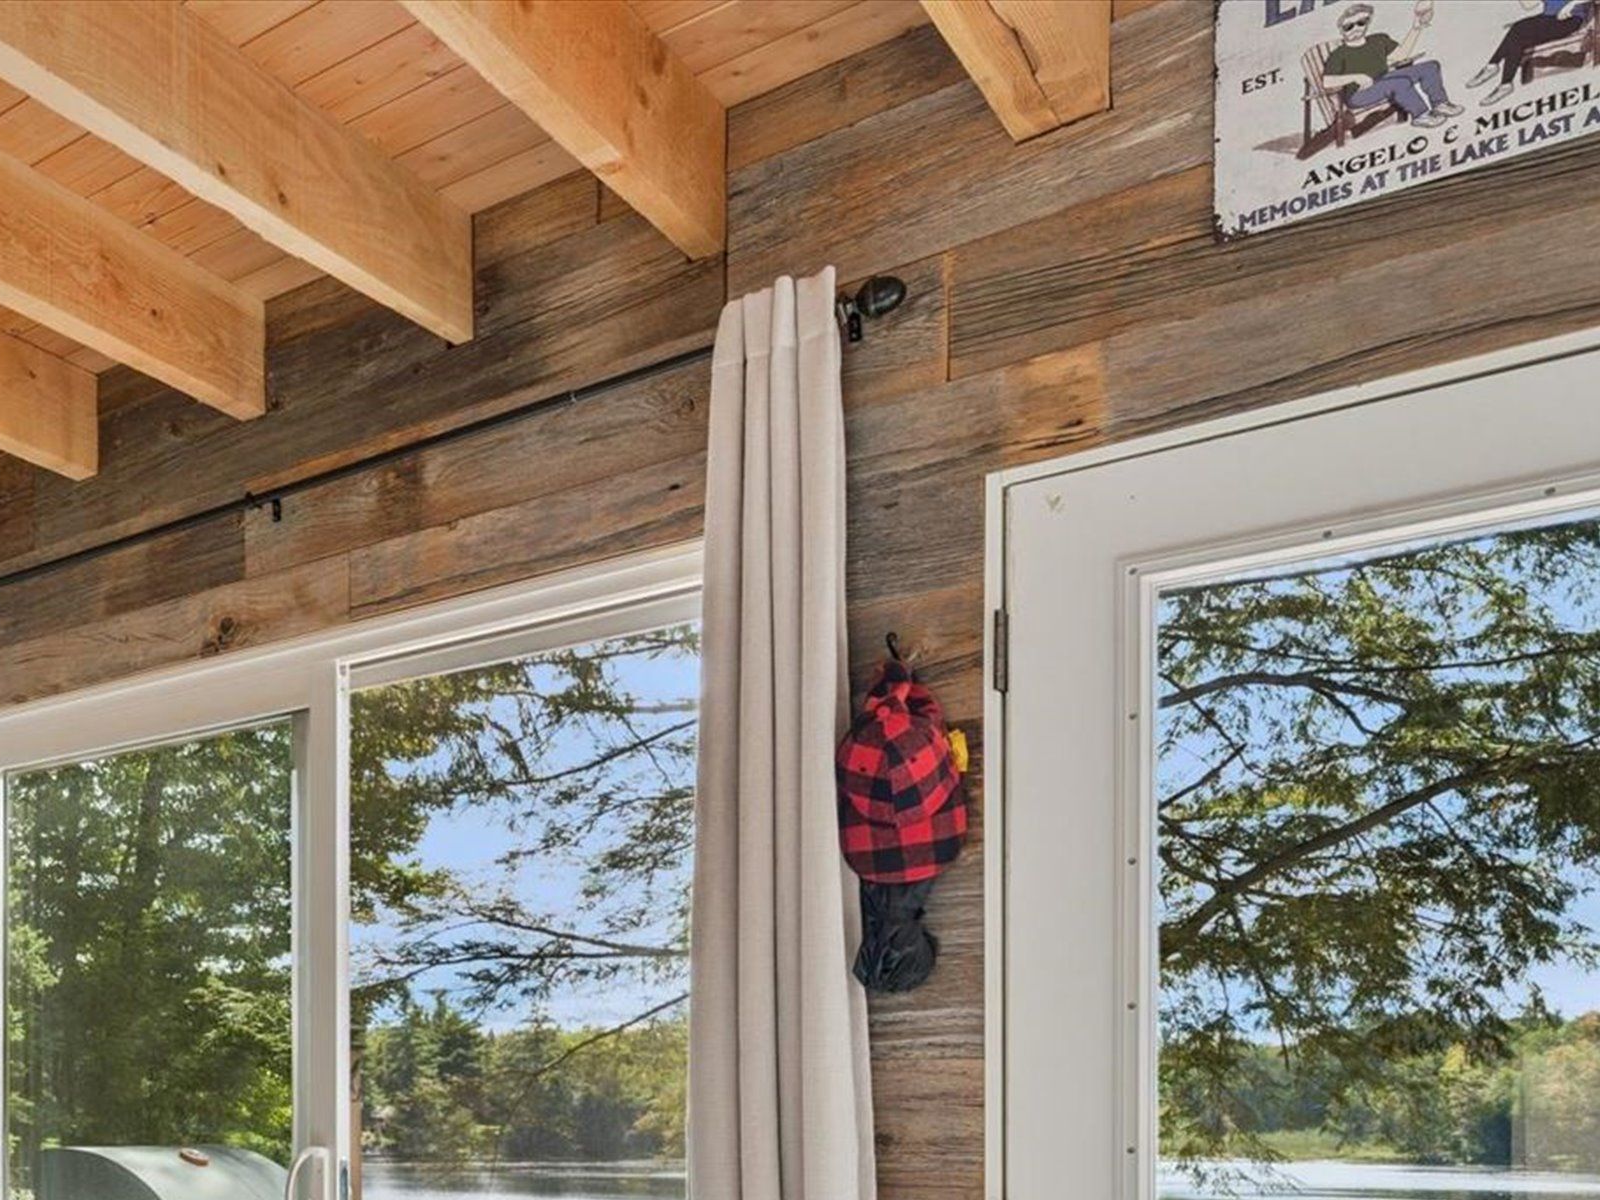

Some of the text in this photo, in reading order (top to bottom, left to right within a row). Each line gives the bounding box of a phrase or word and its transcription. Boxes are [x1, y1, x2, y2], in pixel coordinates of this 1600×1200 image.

[1241, 68, 1285, 95] EST.
[1238, 181, 1353, 231] MEMORIES
[1360, 169, 1391, 195] AT
[1396, 149, 1442, 182] THE
[1449, 133, 1510, 166] LAKE
[1518, 113, 1575, 147] LAST
[1301, 135, 1429, 189] ANGELO
